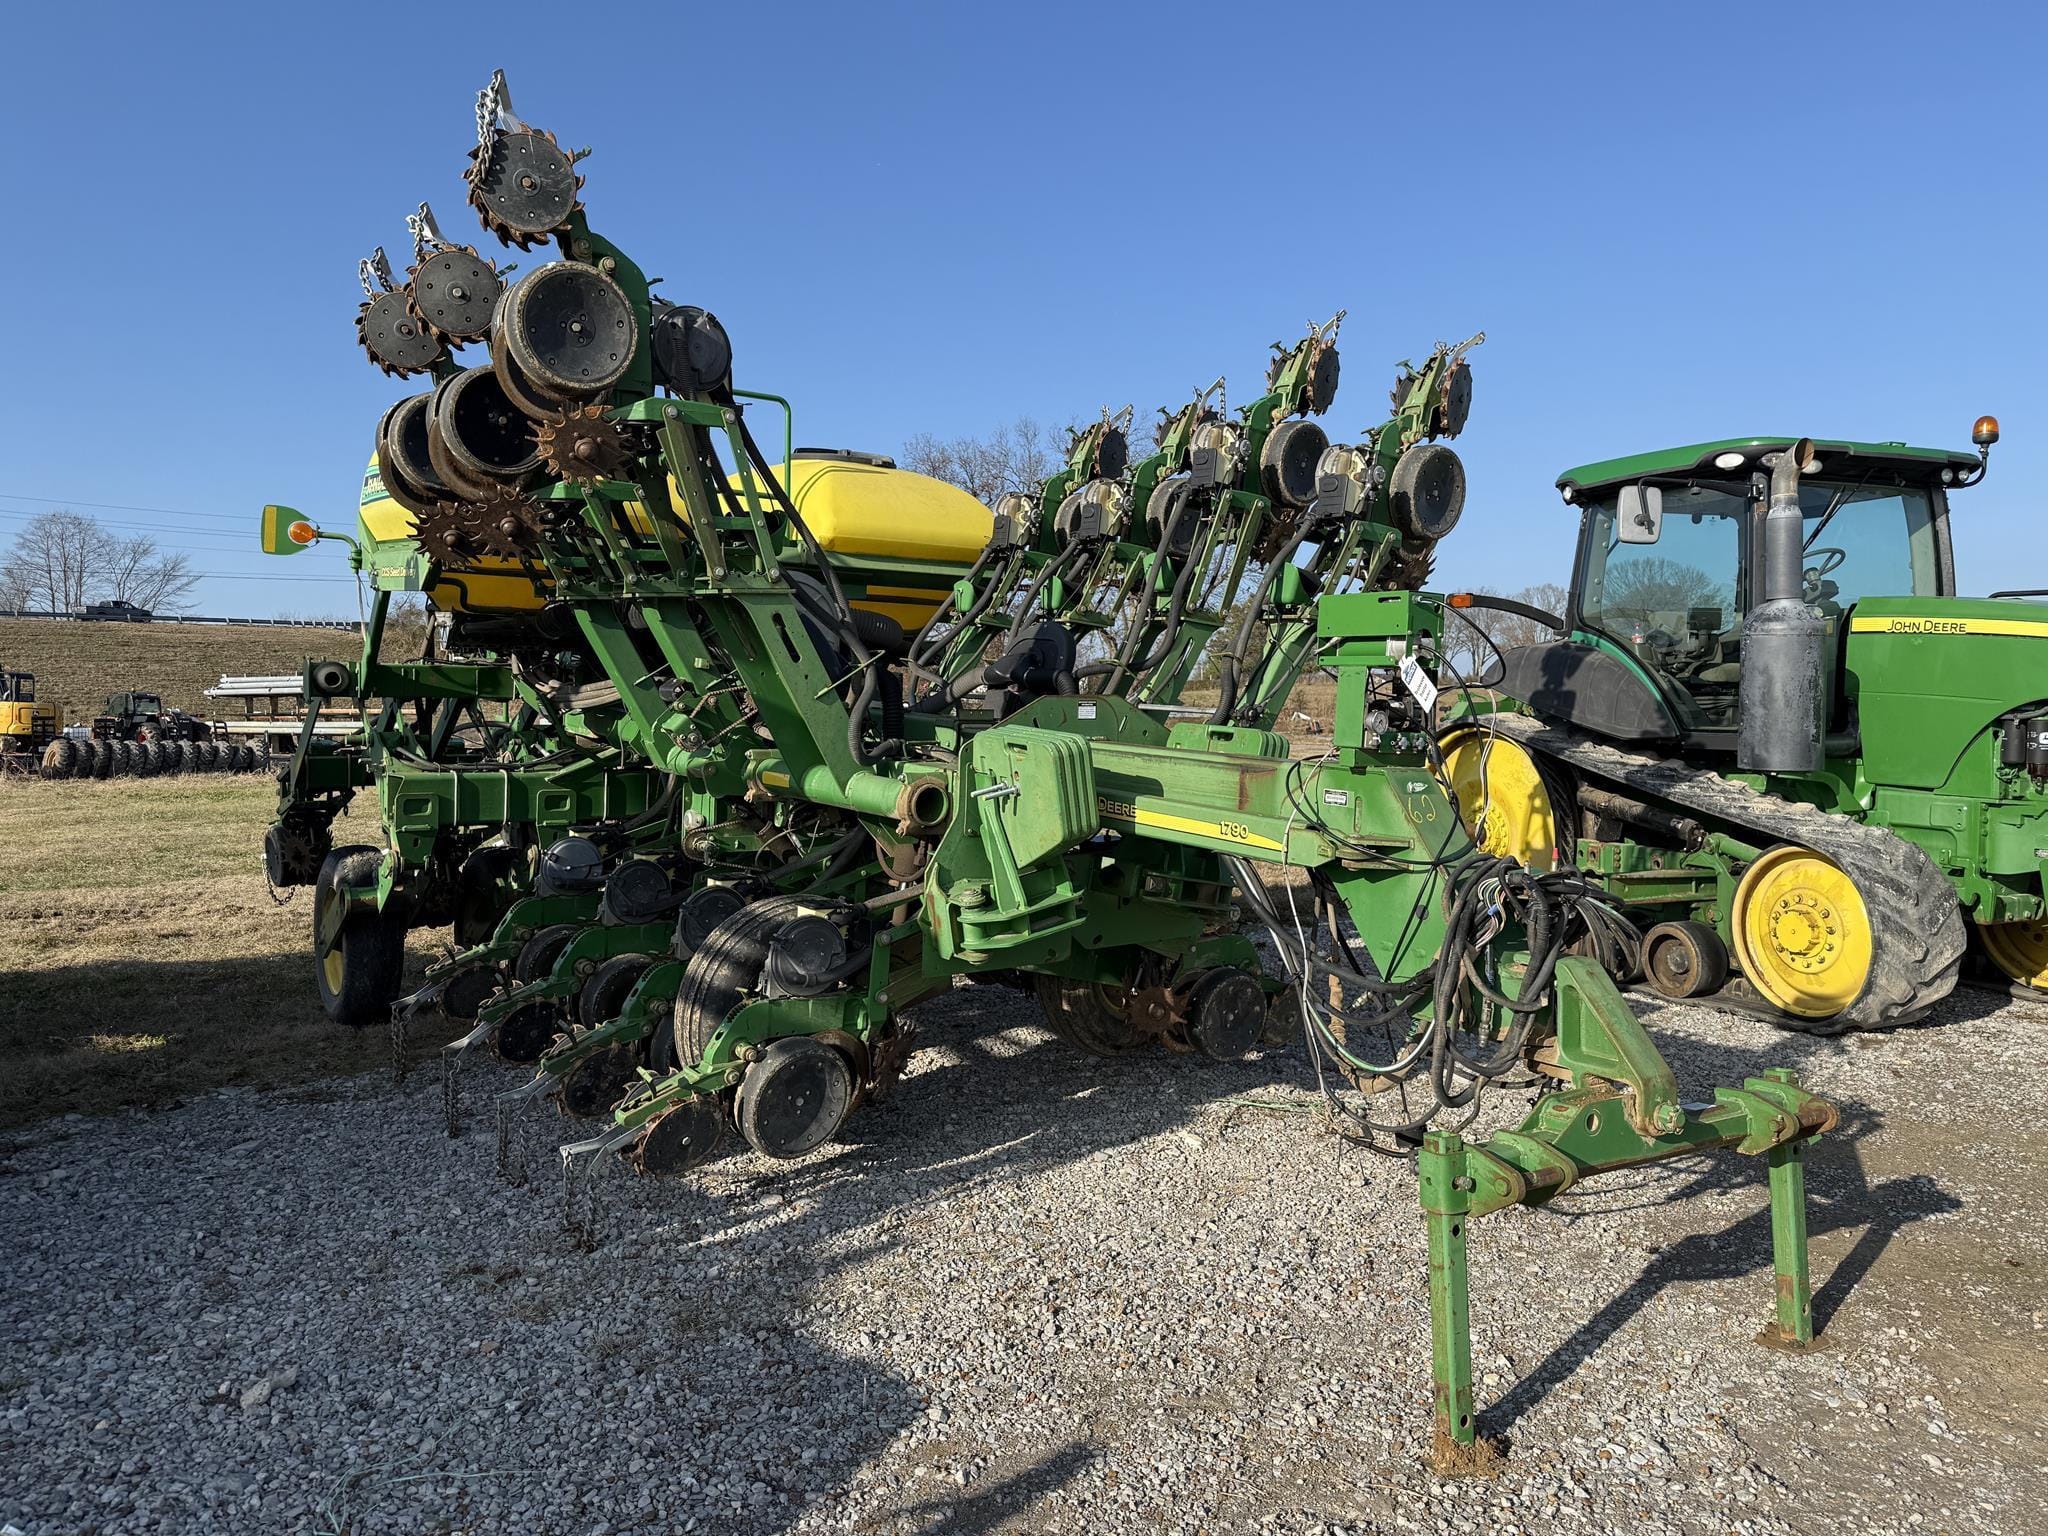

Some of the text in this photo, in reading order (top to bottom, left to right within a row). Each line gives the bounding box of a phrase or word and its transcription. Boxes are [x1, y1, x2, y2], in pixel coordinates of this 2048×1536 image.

[1887, 619, 1968, 633] JOHN DEERE
[1098, 796, 1137, 817] DEERE
[1219, 820, 1249, 839] 1790
